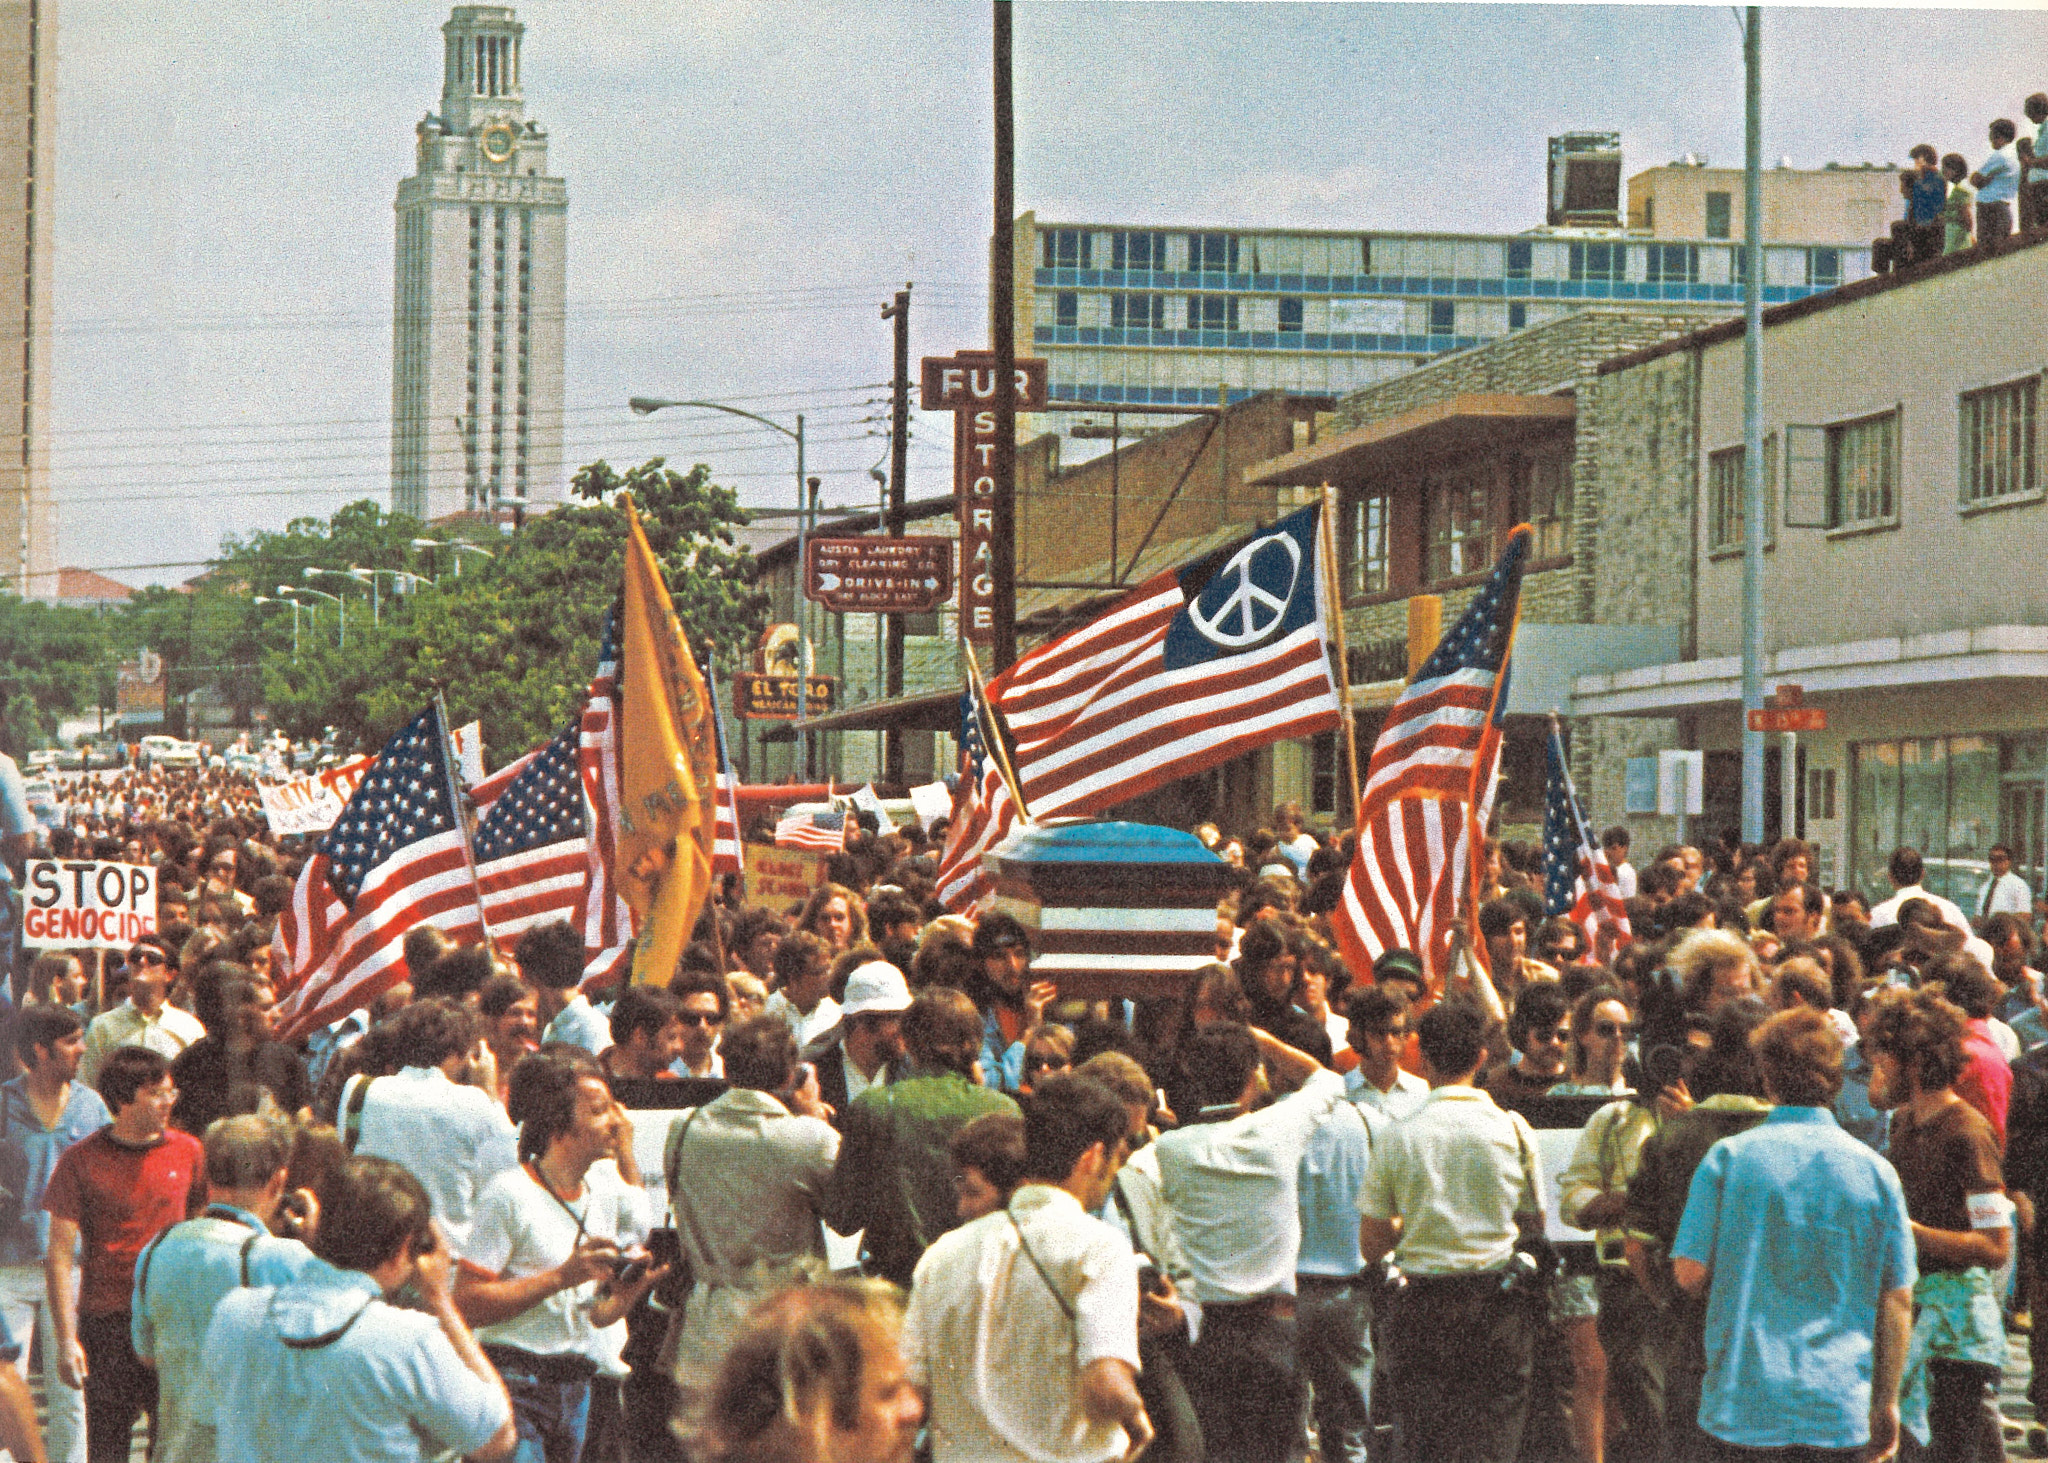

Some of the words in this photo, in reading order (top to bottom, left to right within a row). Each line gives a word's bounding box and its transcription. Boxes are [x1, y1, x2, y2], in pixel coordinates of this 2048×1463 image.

[942, 369, 1029, 400] FUR
[973, 412, 996, 629] STORAGE
[820, 545, 860, 555] AUSTIN
[849, 560, 909, 569] CLEANING
[844, 578, 921, 588] DRIVE-IN
[751, 680, 774, 697] EL
[31, 862, 149, 911] STOP
[25, 908, 155, 943] GENOCIDE
